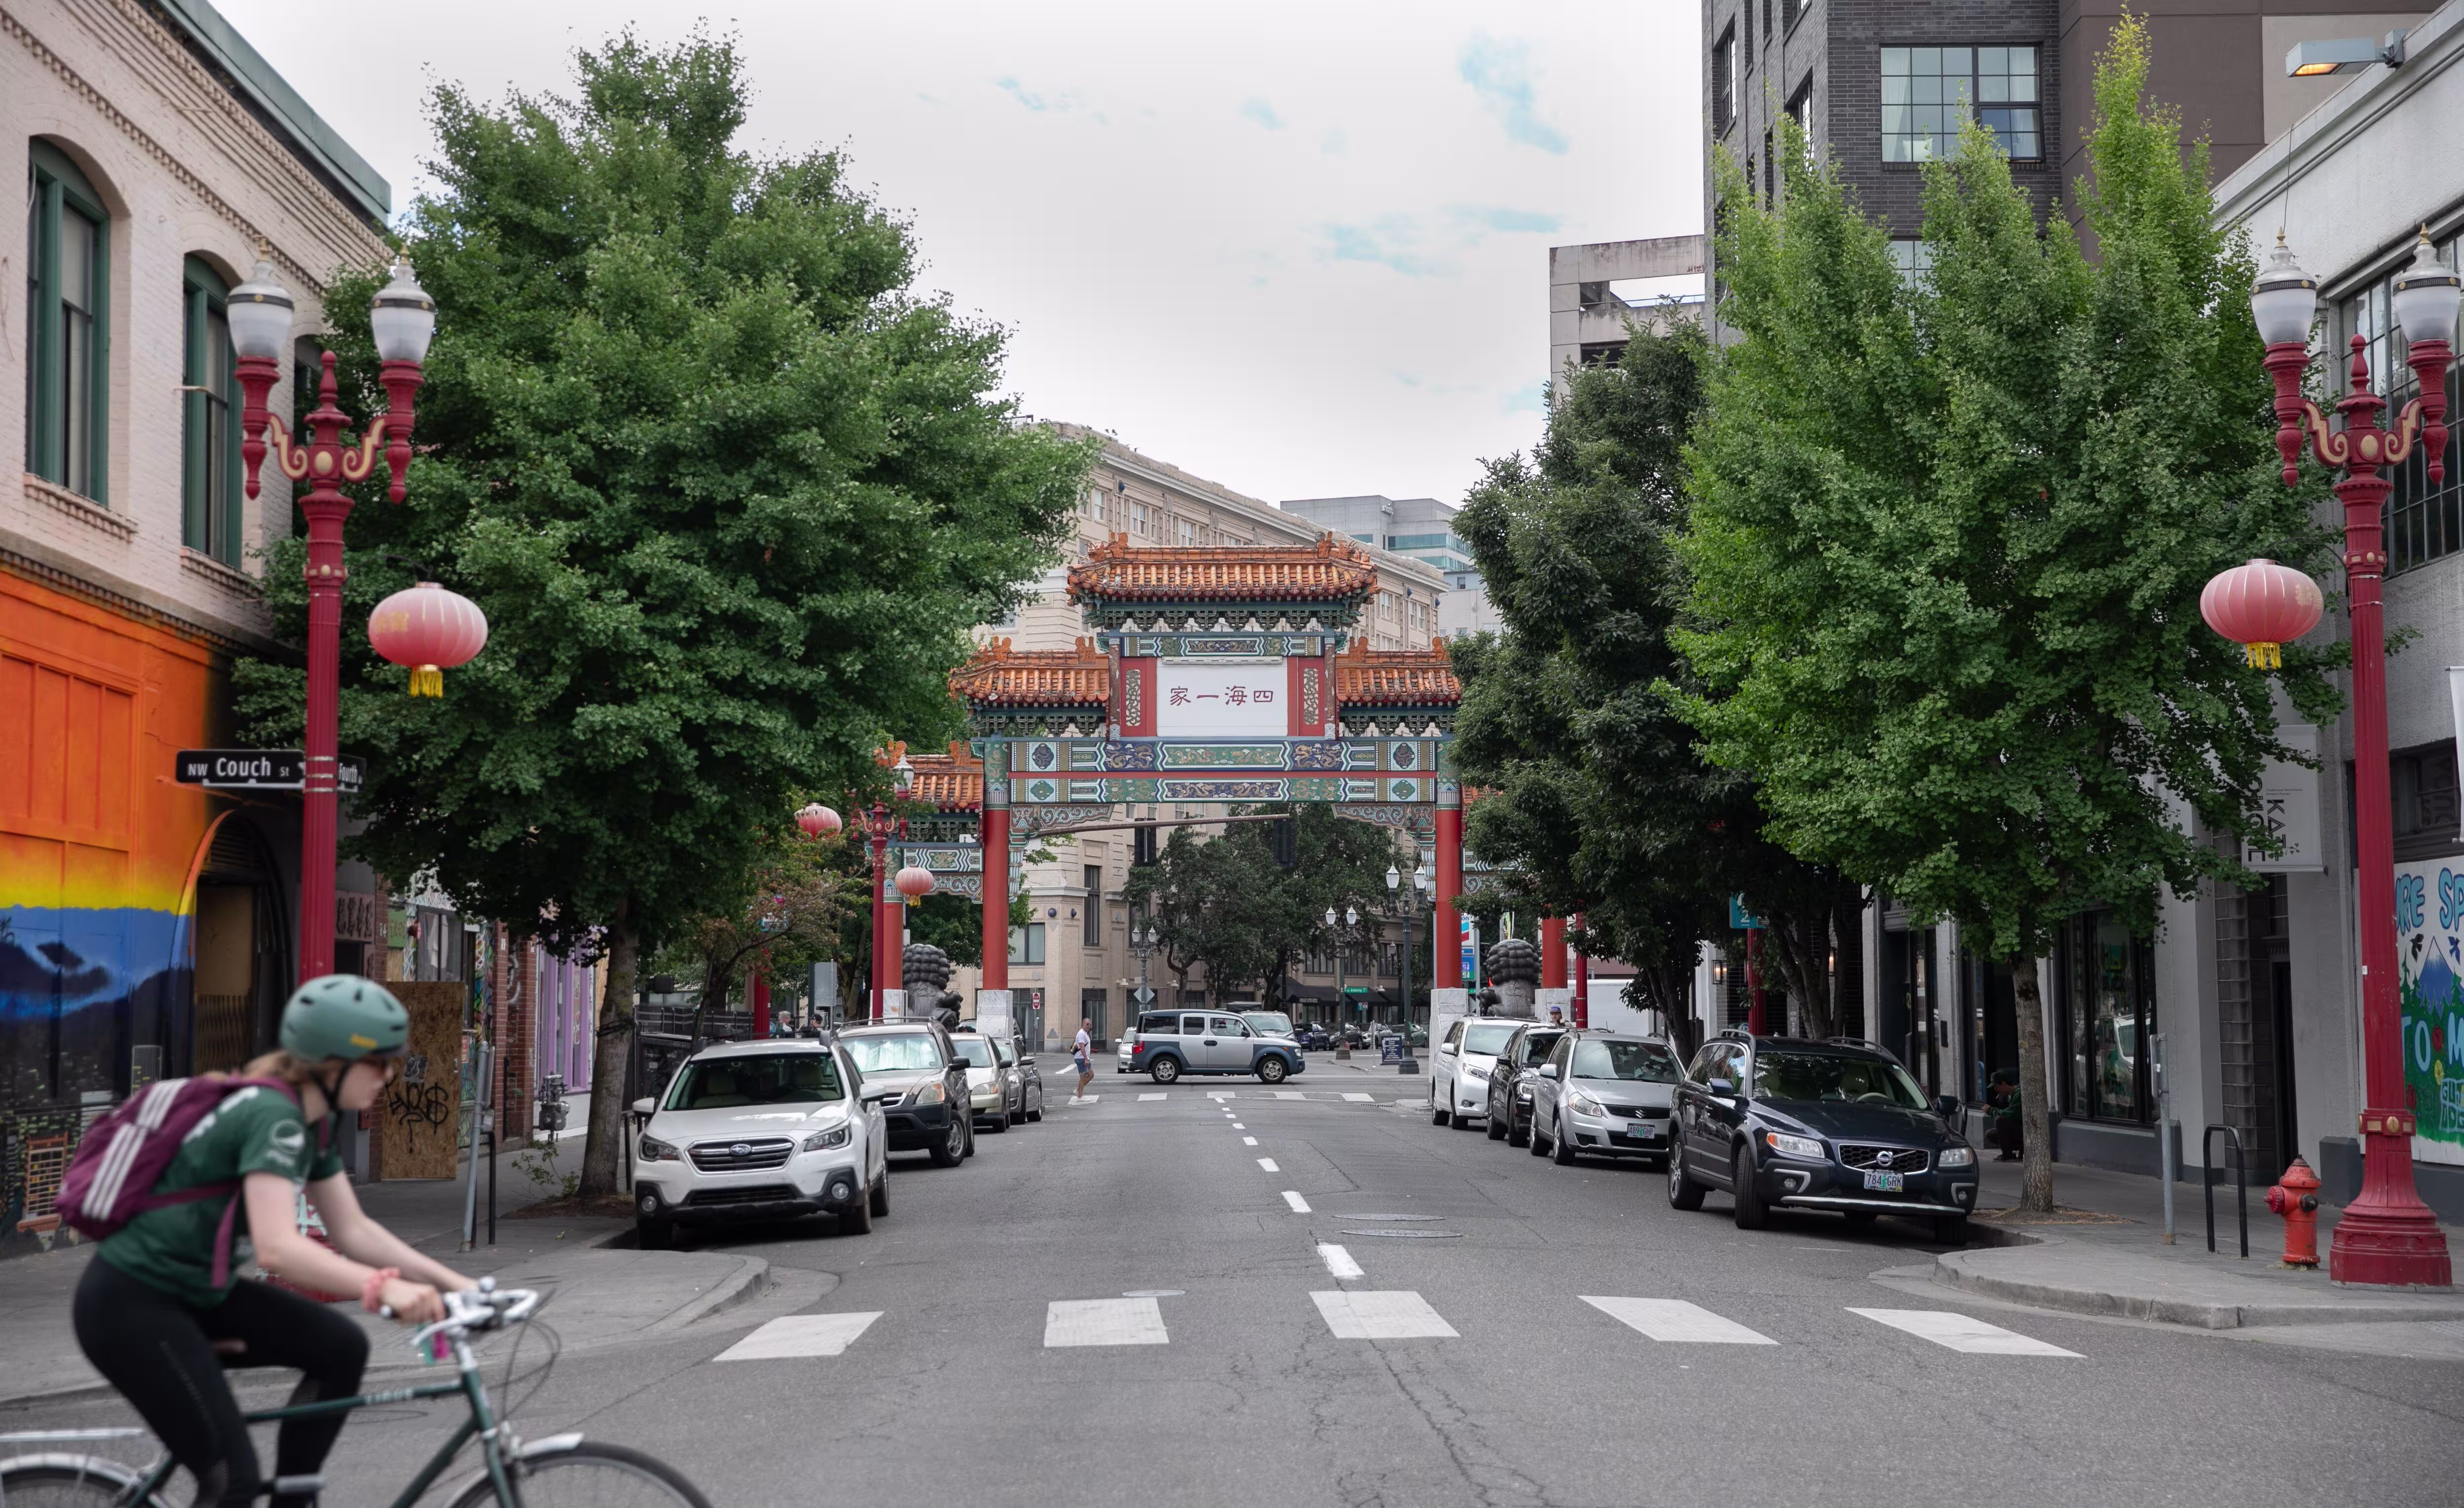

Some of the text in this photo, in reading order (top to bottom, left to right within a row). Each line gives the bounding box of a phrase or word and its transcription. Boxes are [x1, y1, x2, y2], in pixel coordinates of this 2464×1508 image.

[187, 756, 289, 776] NW Couch St
[339, 762, 358, 783] Fourth
[1643, 1127, 1653, 1135] GHP
[1867, 1174, 1902, 1187] 784 GRK
